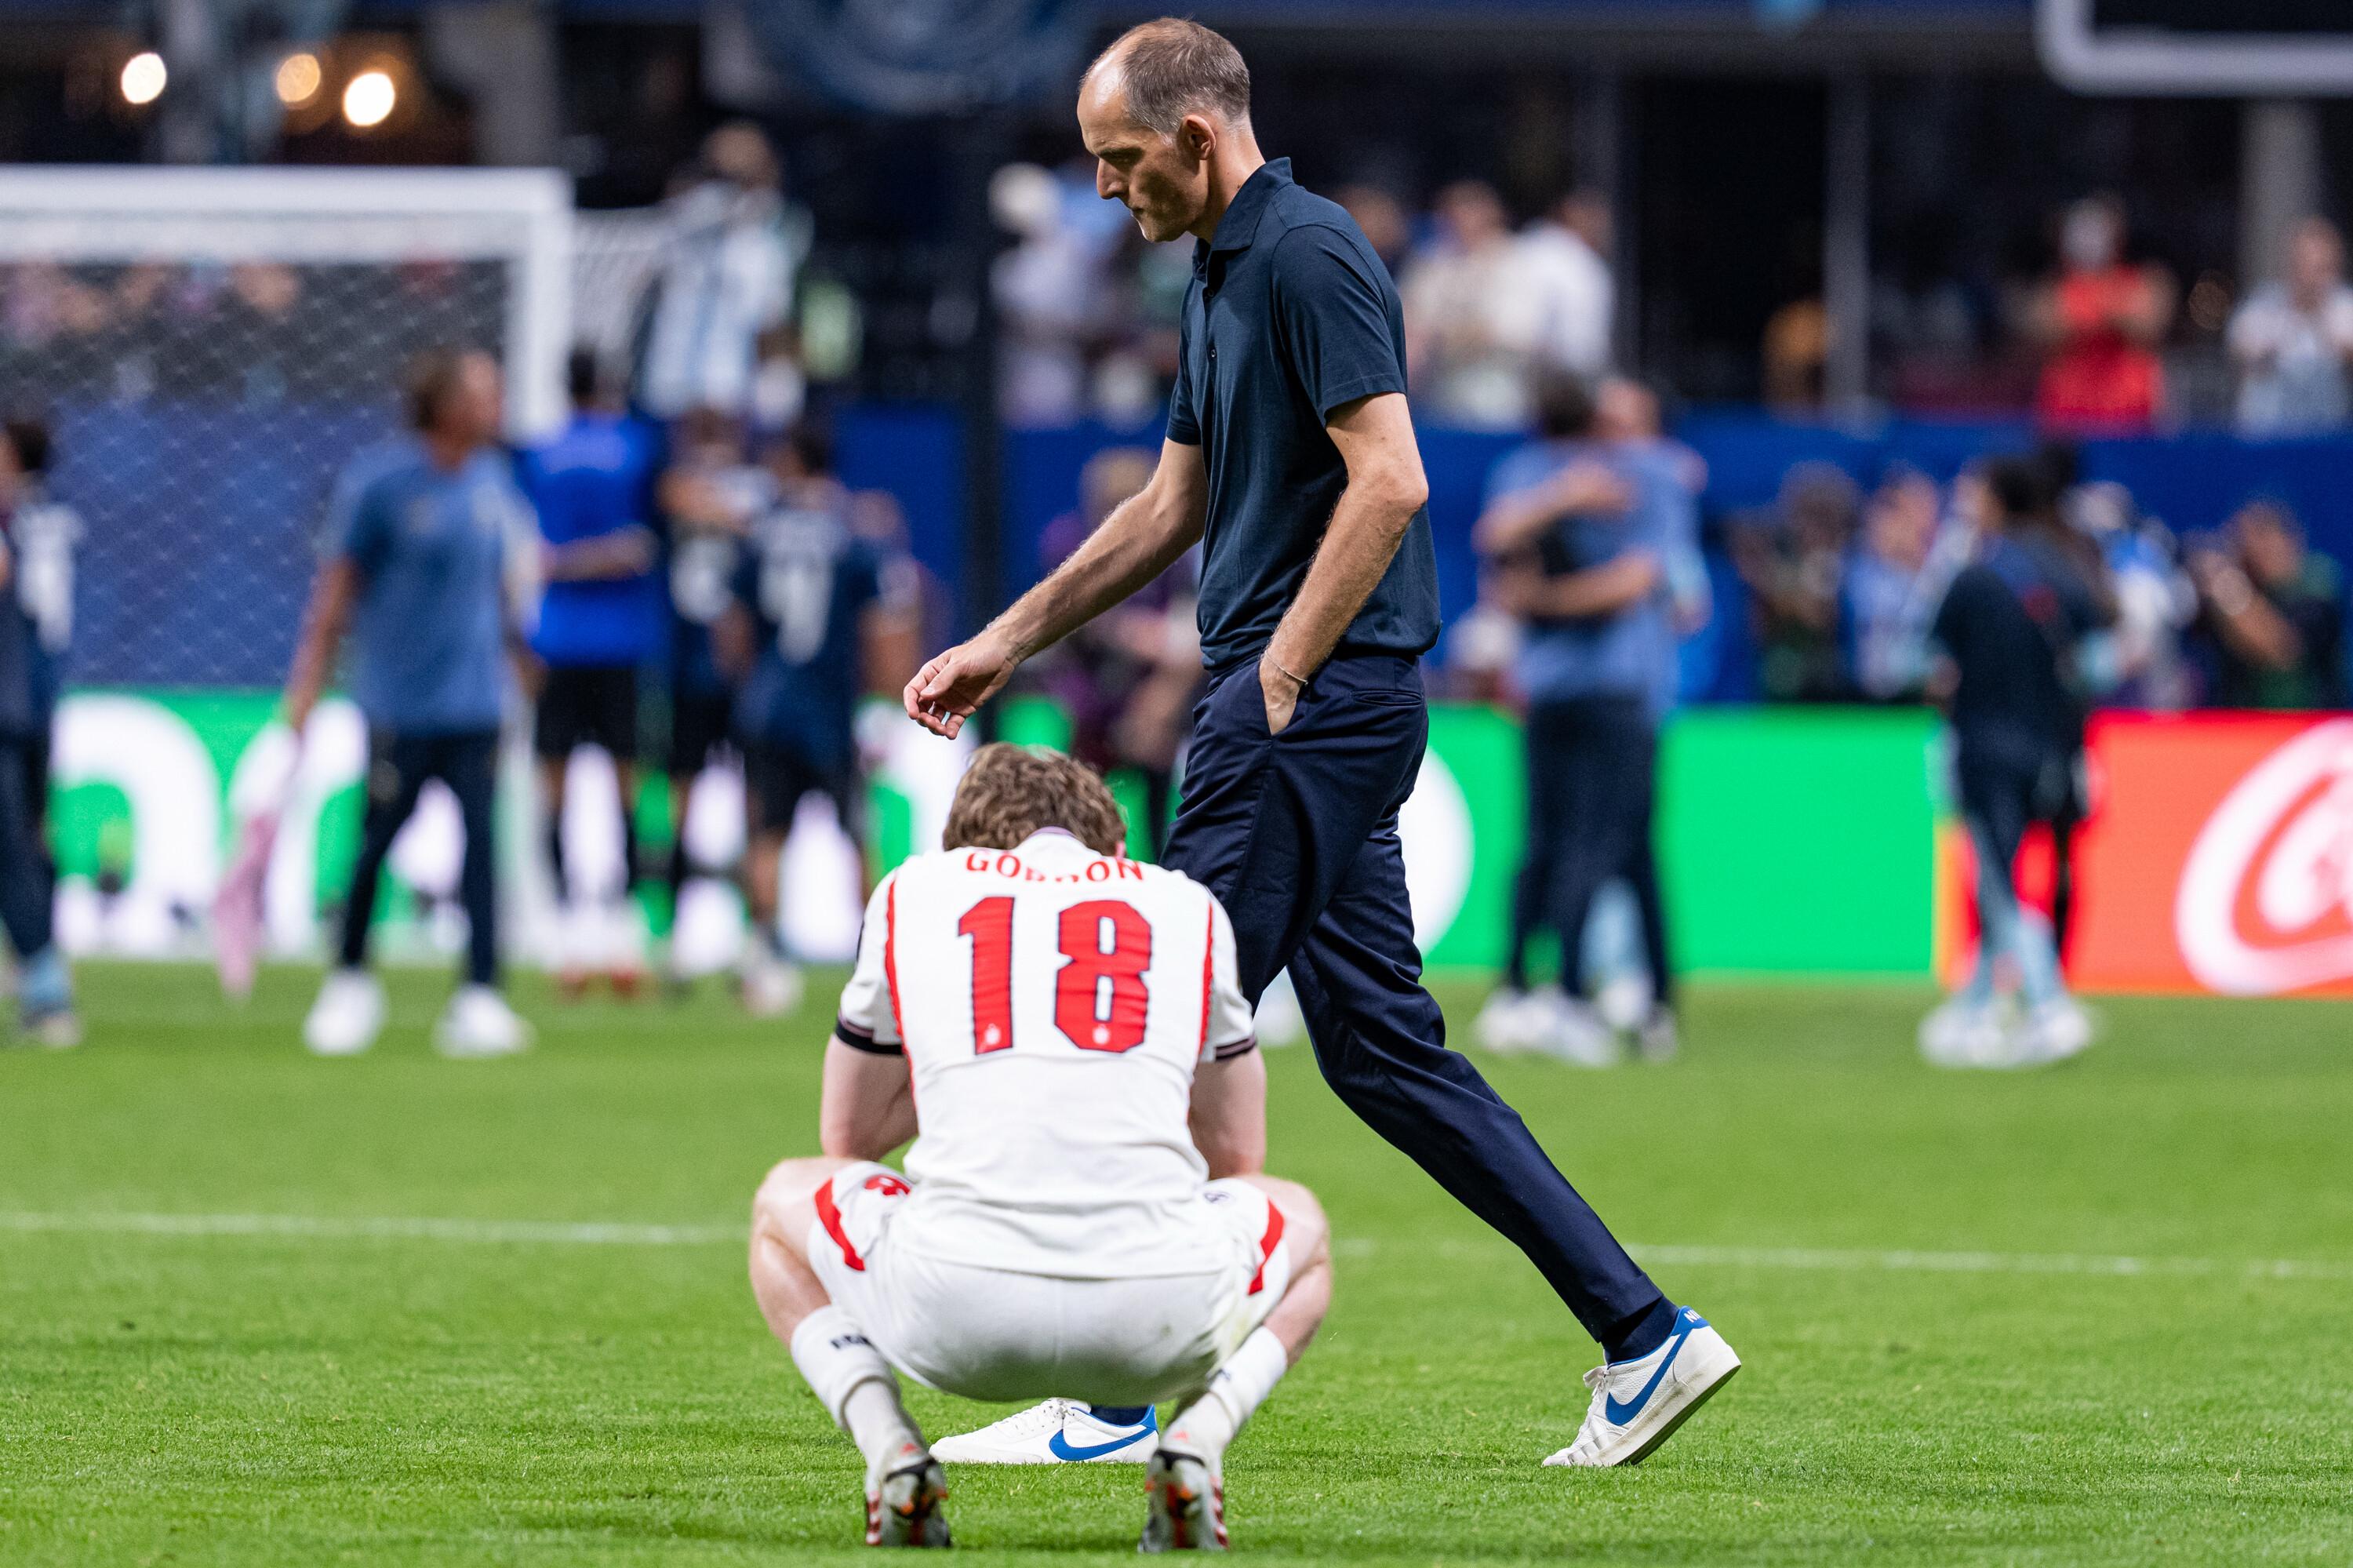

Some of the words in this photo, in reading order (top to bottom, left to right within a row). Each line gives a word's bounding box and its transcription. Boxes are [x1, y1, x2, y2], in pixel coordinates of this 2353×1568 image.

[966, 850, 1144, 883] GOON
[957, 896, 1152, 1056] 18
[1683, 1309, 1702, 1323] NI
